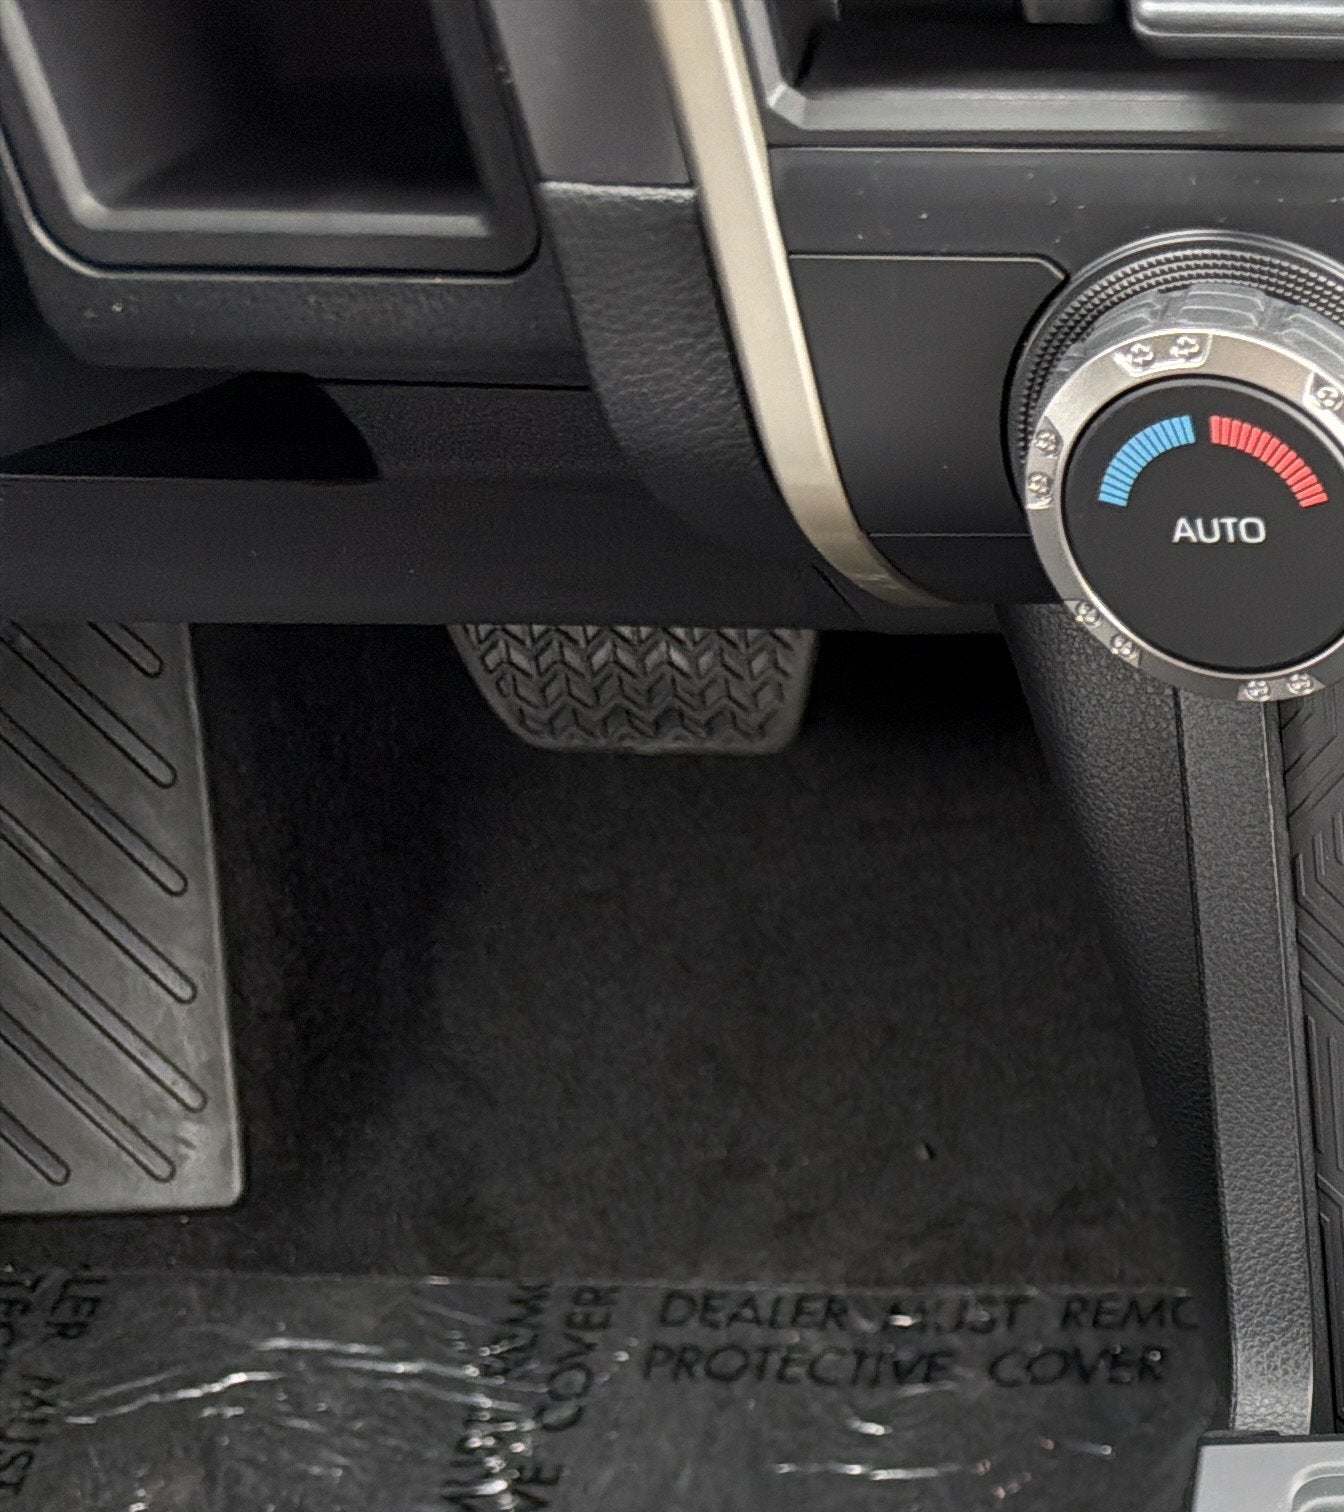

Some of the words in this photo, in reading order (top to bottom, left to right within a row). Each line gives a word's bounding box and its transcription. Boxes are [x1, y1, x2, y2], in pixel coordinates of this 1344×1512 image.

[1173, 515, 1267, 545] AUTO
[657, 1288, 860, 1333] DEALER
[535, 1284, 619, 1432] COVER
[641, 1341, 956, 1387] PROTECTIVE
[987, 1343, 1169, 1388] COVER
